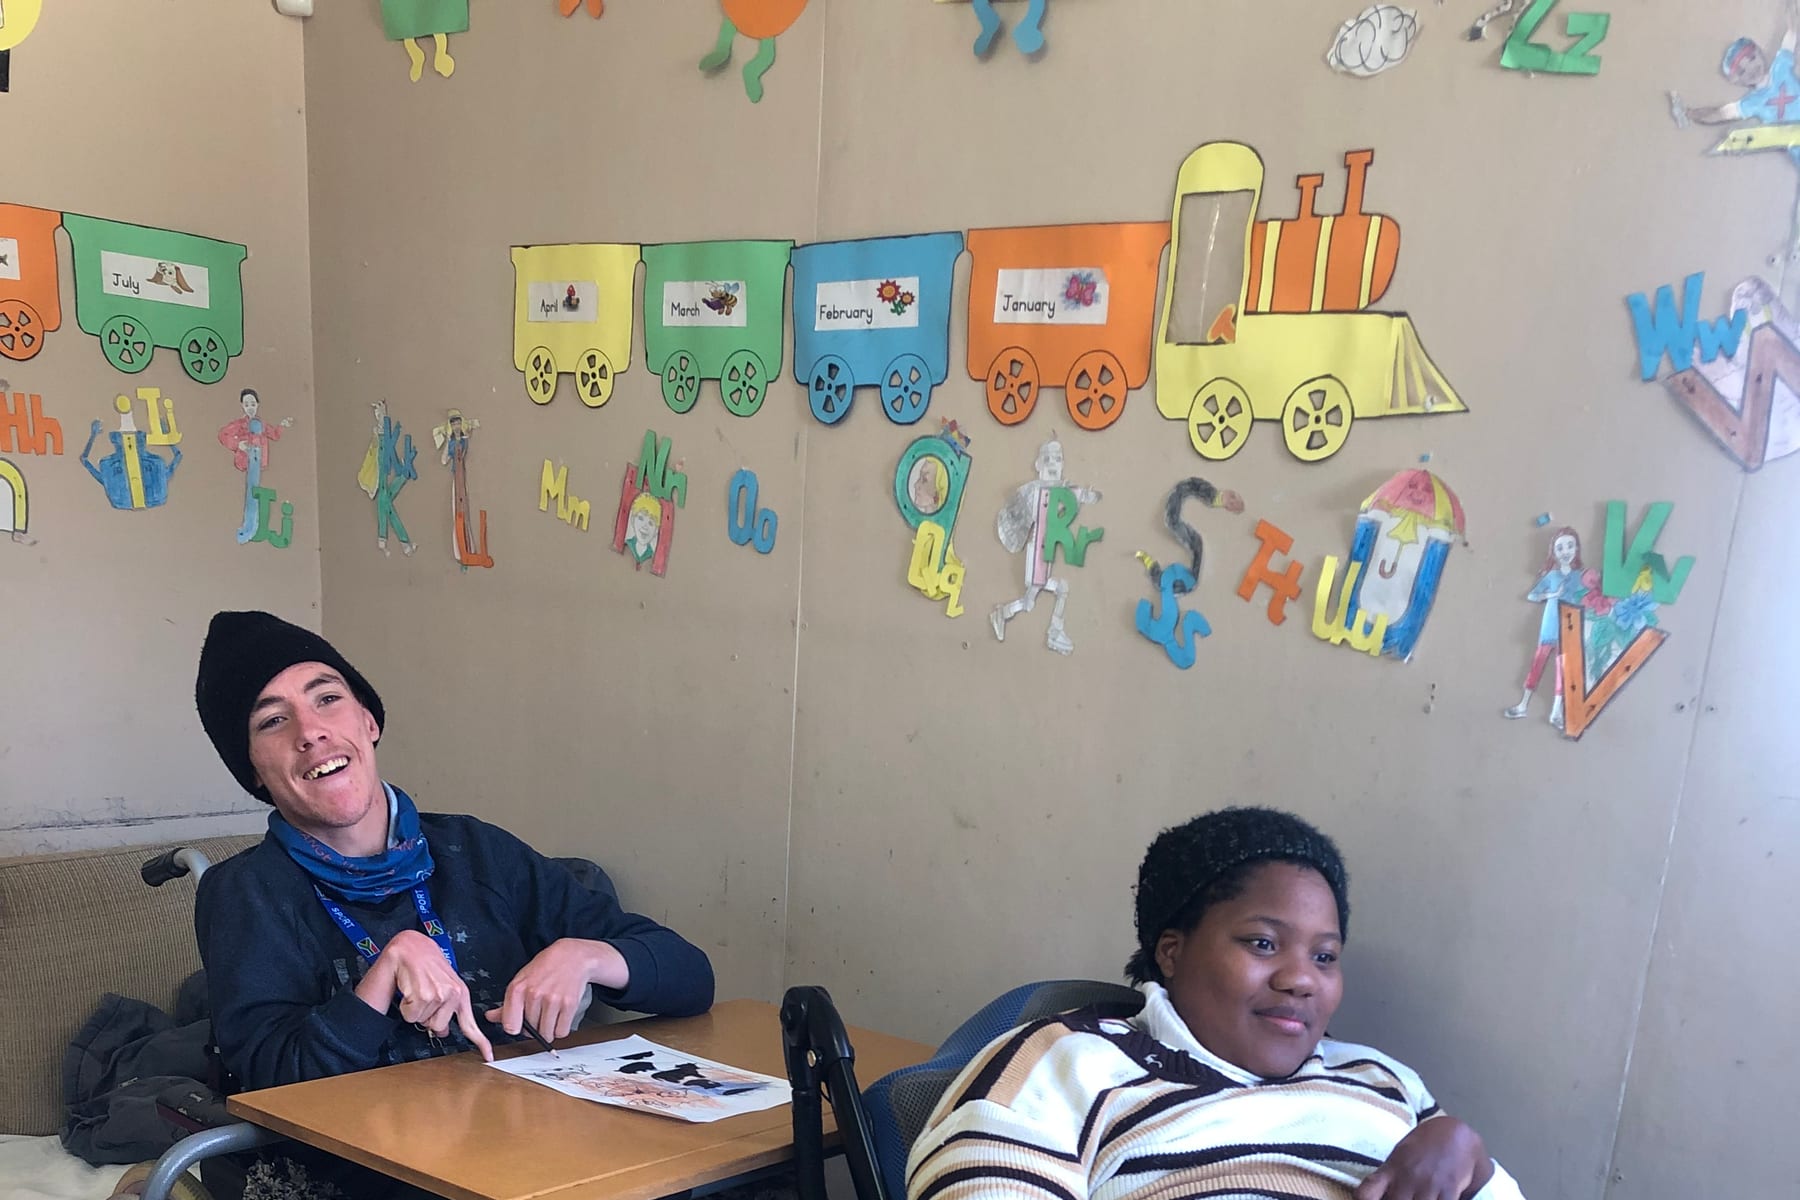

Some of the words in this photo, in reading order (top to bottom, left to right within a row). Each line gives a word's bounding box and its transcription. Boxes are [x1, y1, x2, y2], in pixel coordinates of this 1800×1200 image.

[111, 272, 140, 295] July
[540, 298, 559, 318] April
[670, 301, 700, 317] March
[819, 304, 873, 326] February
[1002, 294, 1056, 319] January
[1625, 271, 1748, 383] Ww
[0, 391, 64, 456] Hh
[1043, 486, 1104, 568] Rr
[414, 888, 430, 915] SPORT
[331, 906, 356, 929] SPORT
